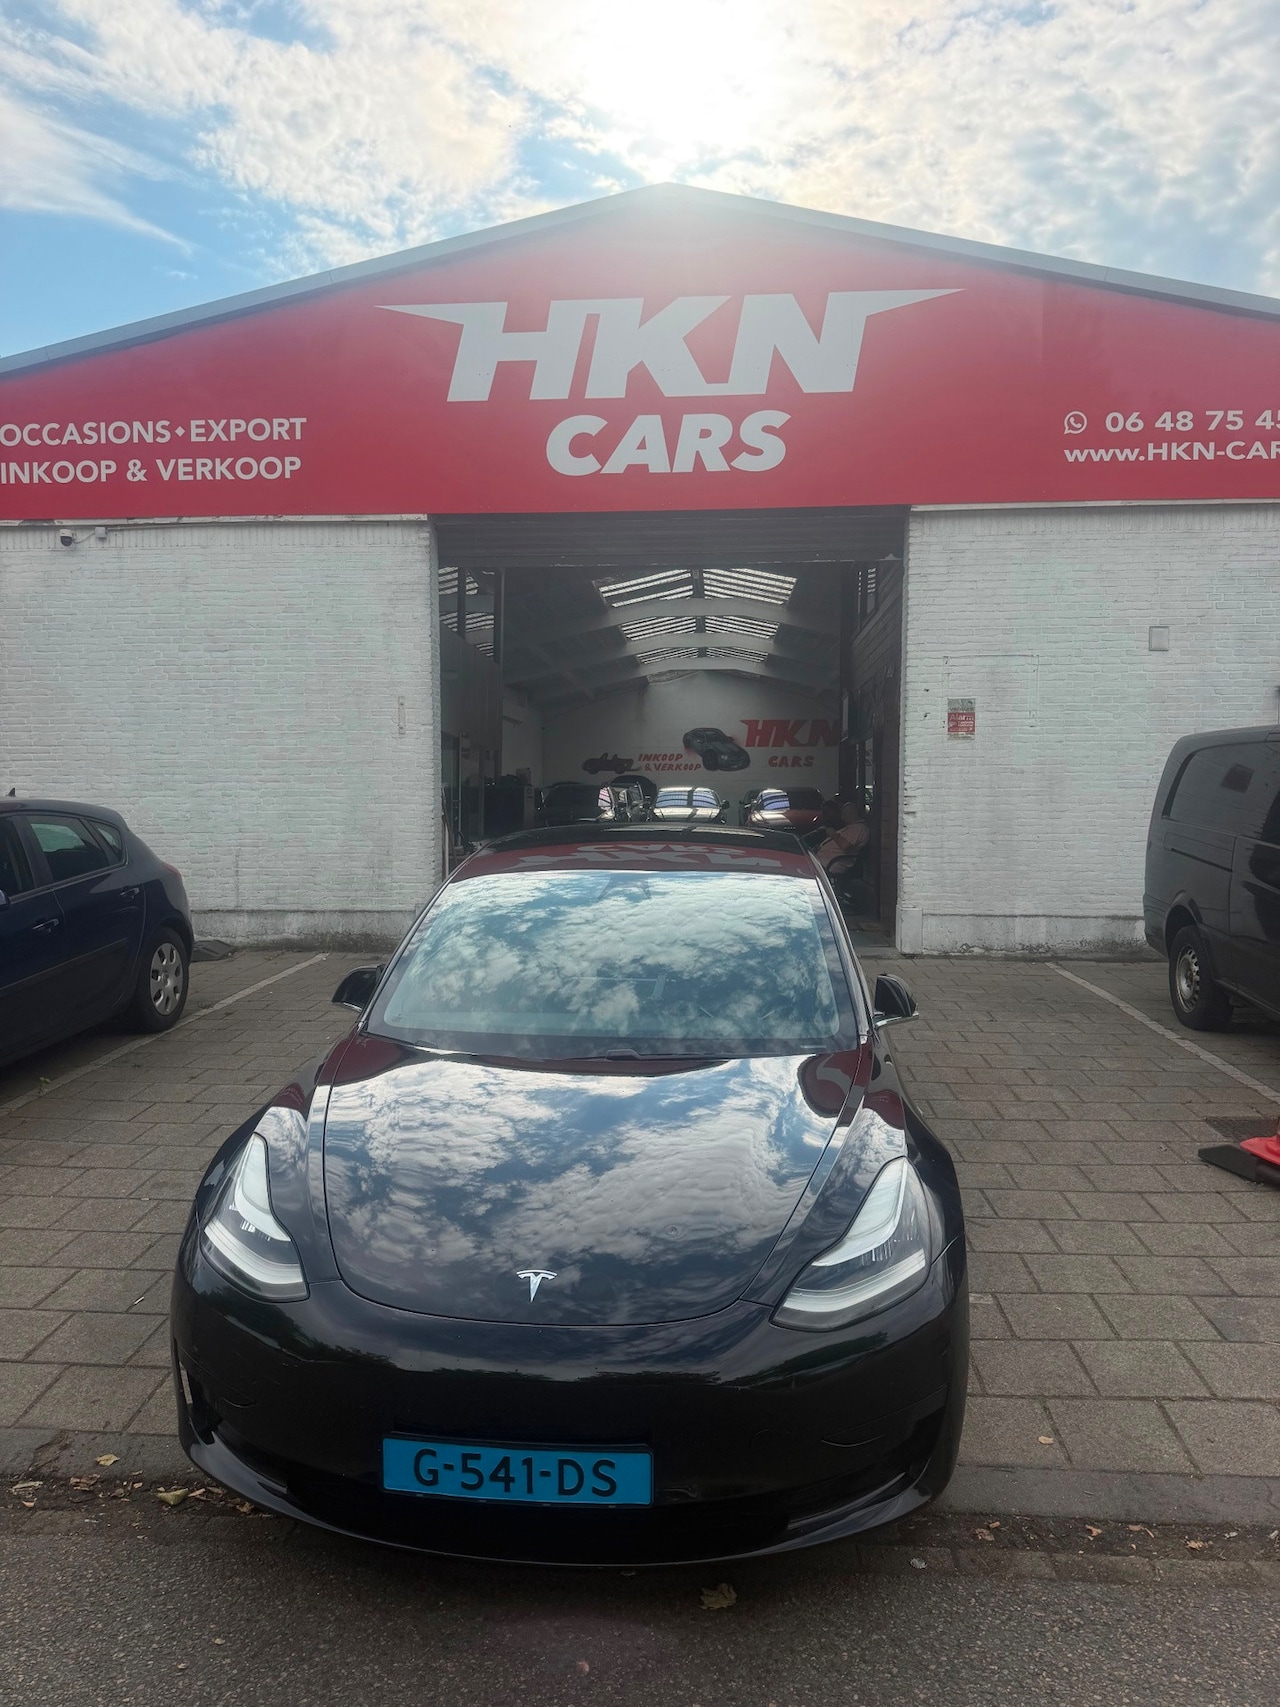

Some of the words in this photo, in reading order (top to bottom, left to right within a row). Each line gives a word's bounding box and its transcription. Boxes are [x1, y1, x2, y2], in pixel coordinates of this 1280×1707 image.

[378, 288, 966, 402] HKN
[0, 419, 172, 447] OCCASIONS
[189, 417, 308, 442] EXPORT
[1105, 411, 1145, 433] 06
[1154, 411, 1194, 432] 48
[1205, 409, 1245, 431] 75
[1254, 409, 1280, 431] 4
[545, 410, 791, 476] CARS
[0, 460, 118, 484] INKOOP
[126, 459, 148, 482] &
[155, 456, 302, 481] VERKOOP
[739, 719, 841, 747] HKN
[637, 753, 684, 762] INKOOP
[768, 755, 815, 768] CARS
[413, 1448, 617, 1497] G-541-DS
